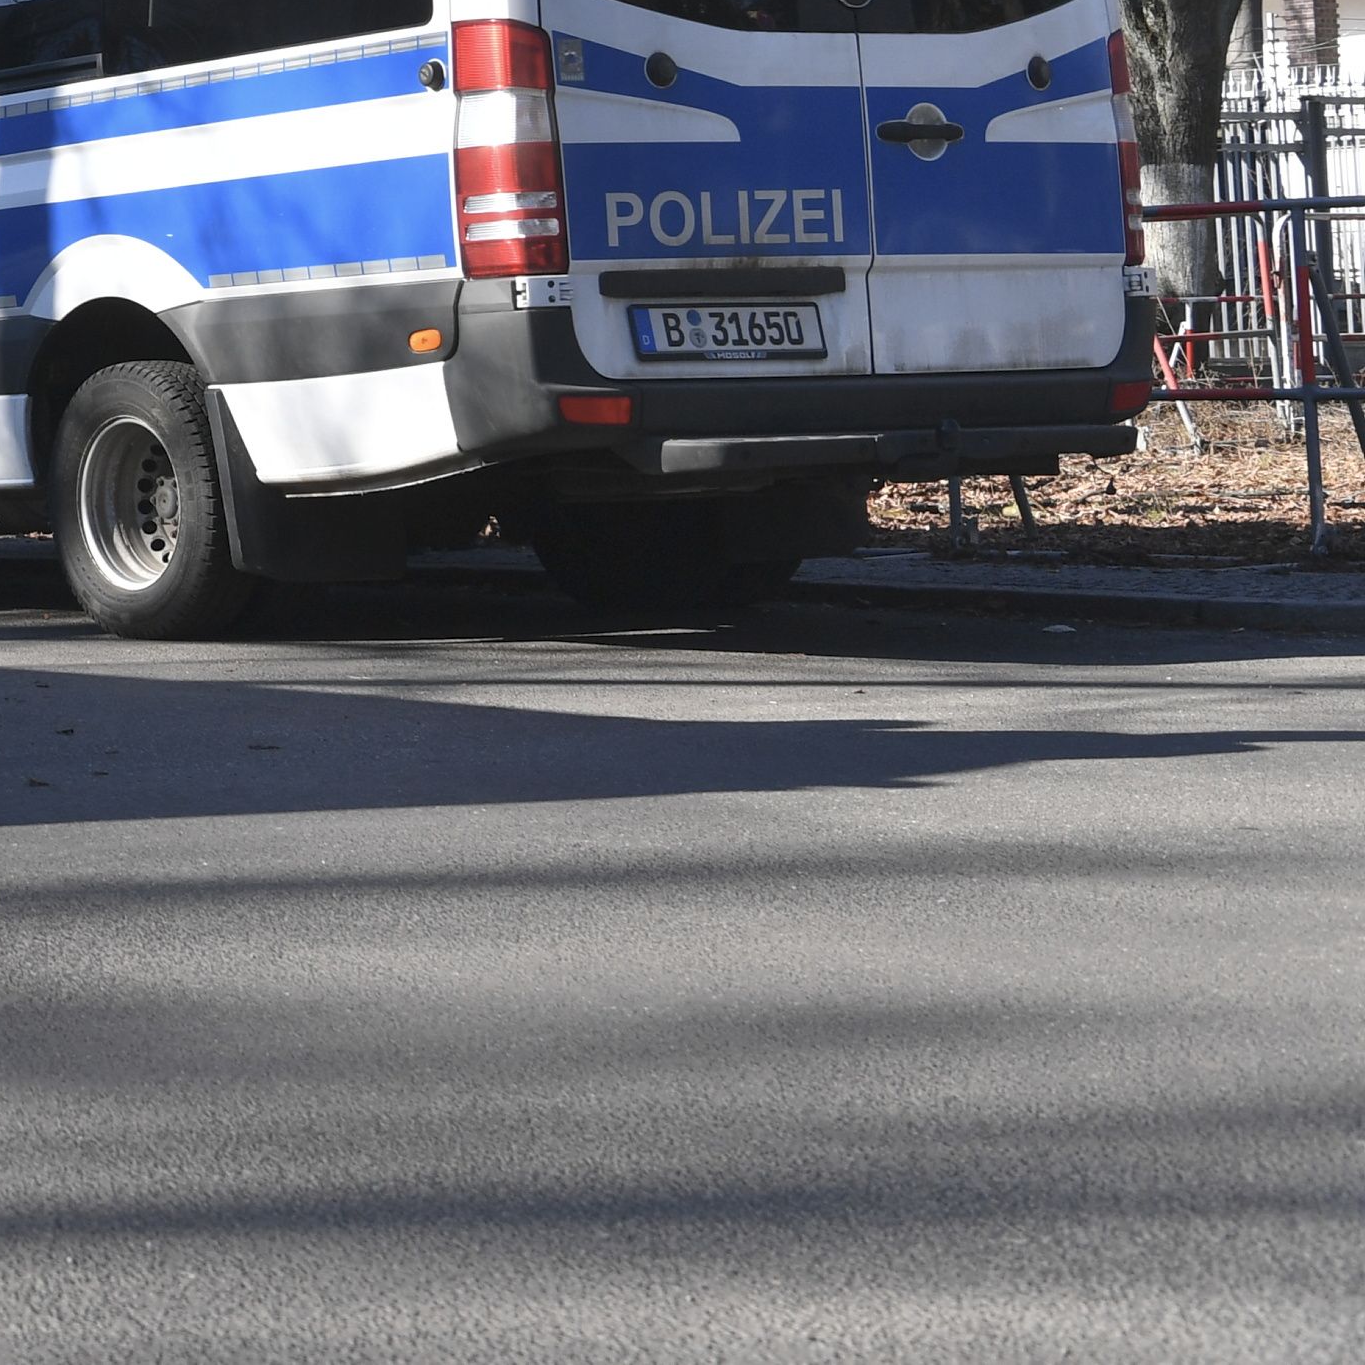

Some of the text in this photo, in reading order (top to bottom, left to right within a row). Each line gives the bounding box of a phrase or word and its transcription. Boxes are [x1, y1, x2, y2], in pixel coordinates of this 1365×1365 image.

[605, 189, 844, 246] POLIZEI
[642, 311, 804, 347] D B 31650
